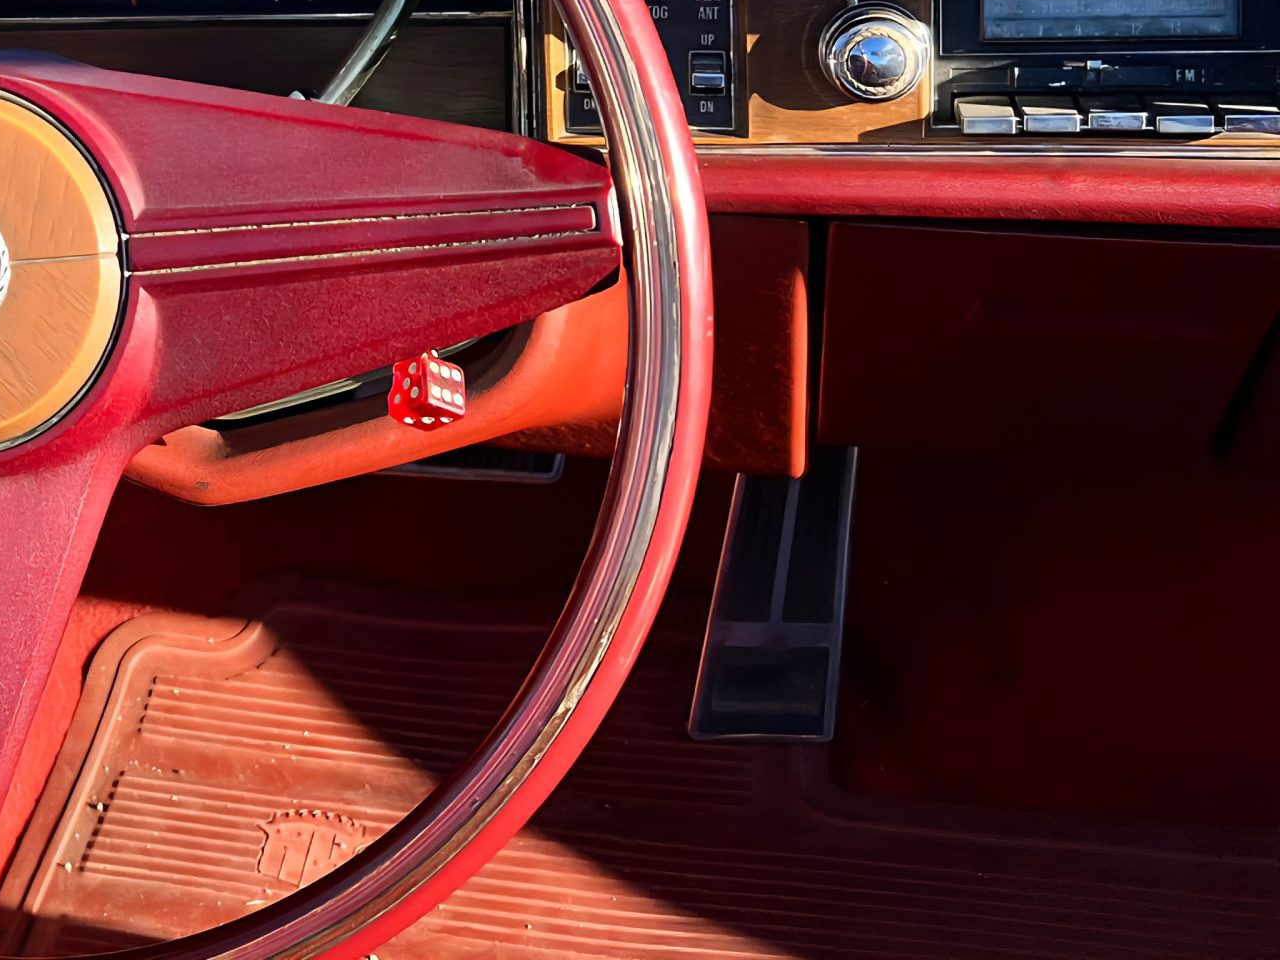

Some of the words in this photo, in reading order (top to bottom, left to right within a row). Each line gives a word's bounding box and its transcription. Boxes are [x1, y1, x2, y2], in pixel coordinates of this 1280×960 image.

[698, 5, 720, 20] ANT
[700, 33, 715, 45] UP
[1175, 68, 1196, 82] FM
[699, 100, 714, 113] DN
